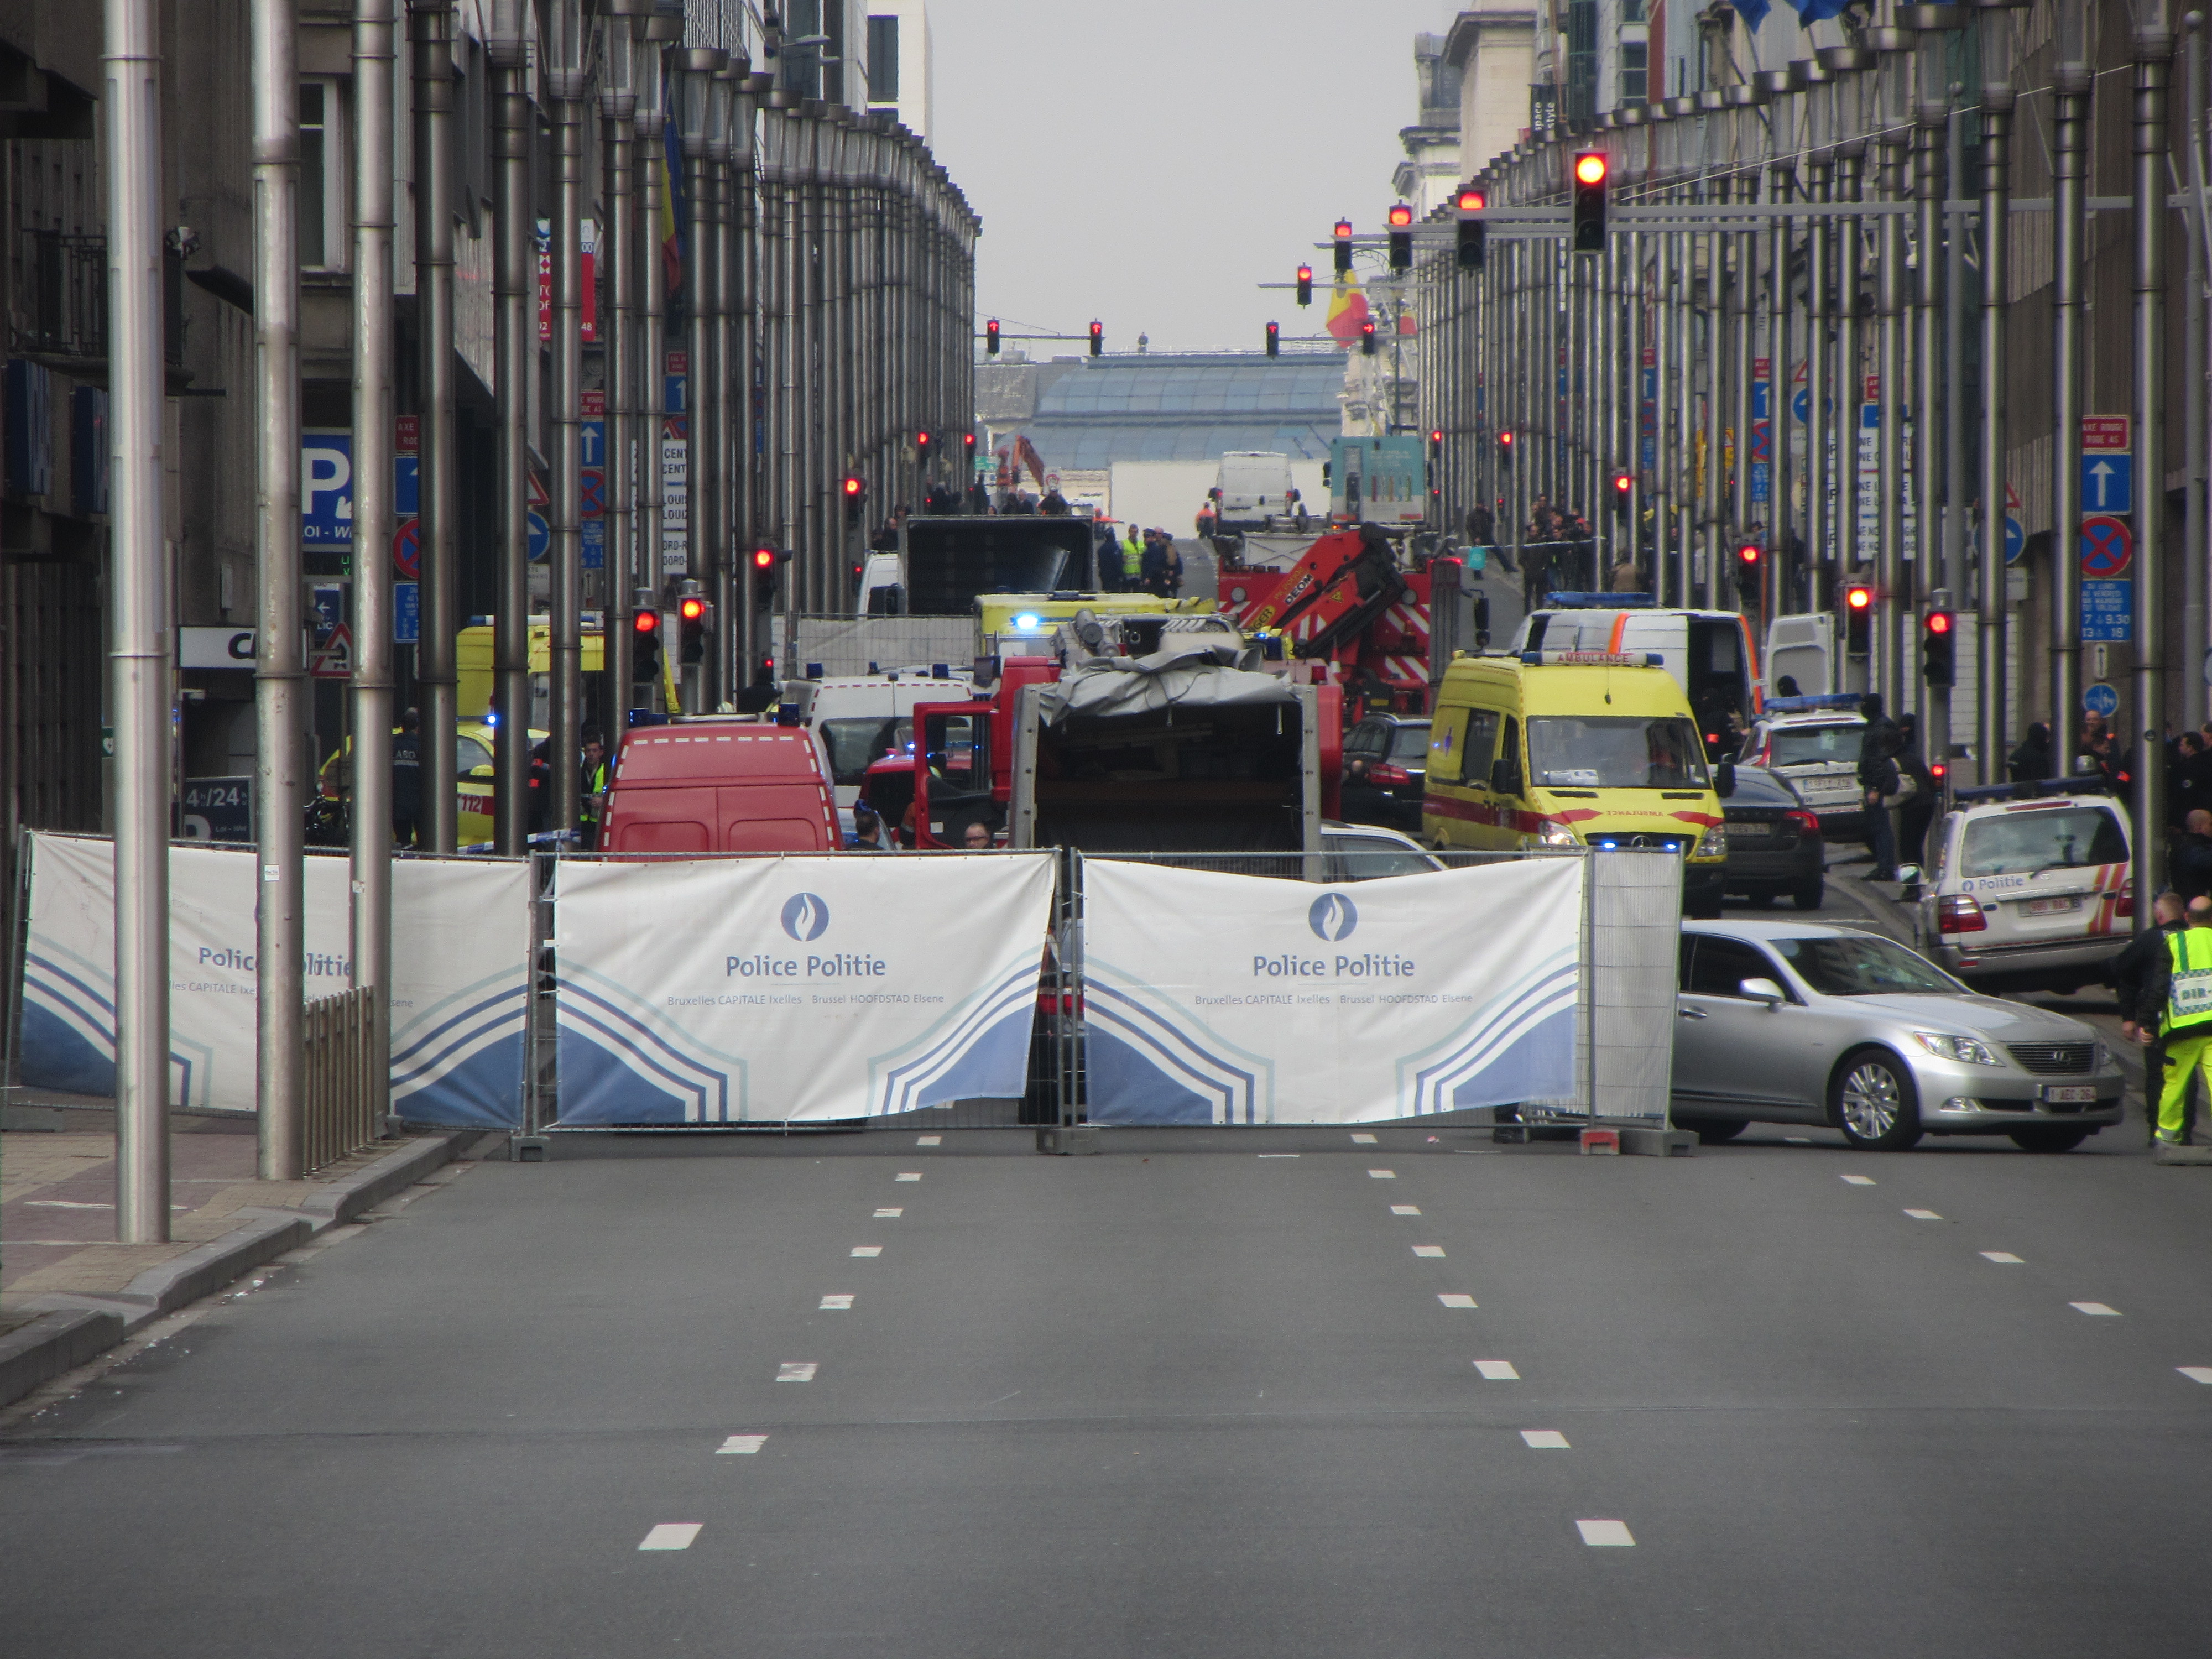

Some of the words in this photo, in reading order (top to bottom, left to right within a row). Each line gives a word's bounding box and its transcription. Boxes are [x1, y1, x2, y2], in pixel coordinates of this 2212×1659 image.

[398, 422, 415, 431] AXE
[301, 448, 350, 514] P
[303, 525, 320, 538] OI
[334, 526, 351, 538] W
[1285, 573, 1313, 604] DEOM
[1558, 653, 1629, 662] AMBULANCE
[462, 795, 481, 812] 112
[1979, 876, 2023, 890] Politie
[199, 946, 255, 972] Polic
[305, 952, 353, 977] litie
[726, 955, 798, 977] Police
[807, 953, 886, 977] Politie
[1254, 954, 1326, 976] Police
[1335, 953, 1415, 977] Politie
[189, 982, 237, 994] CAPITALE
[668, 996, 716, 1006] Bruxelles
[718, 995, 765, 1005] CAPITALE
[770, 994, 802, 1004] Ixelles
[812, 995, 846, 1004] Brussel
[851, 995, 910, 1004] HOOFDSTAD
[914, 994, 944, 1003] Elsene
[1195, 995, 1243, 1005] Bruxelles
[1246, 995, 1293, 1004] CAPITALE
[1297, 994, 1330, 1004] Ixelles
[1340, 994, 1374, 1004] Brussel
[1379, 994, 1438, 1004] HOOFDSTAD
[1442, 994, 1473, 1003] Elsene
